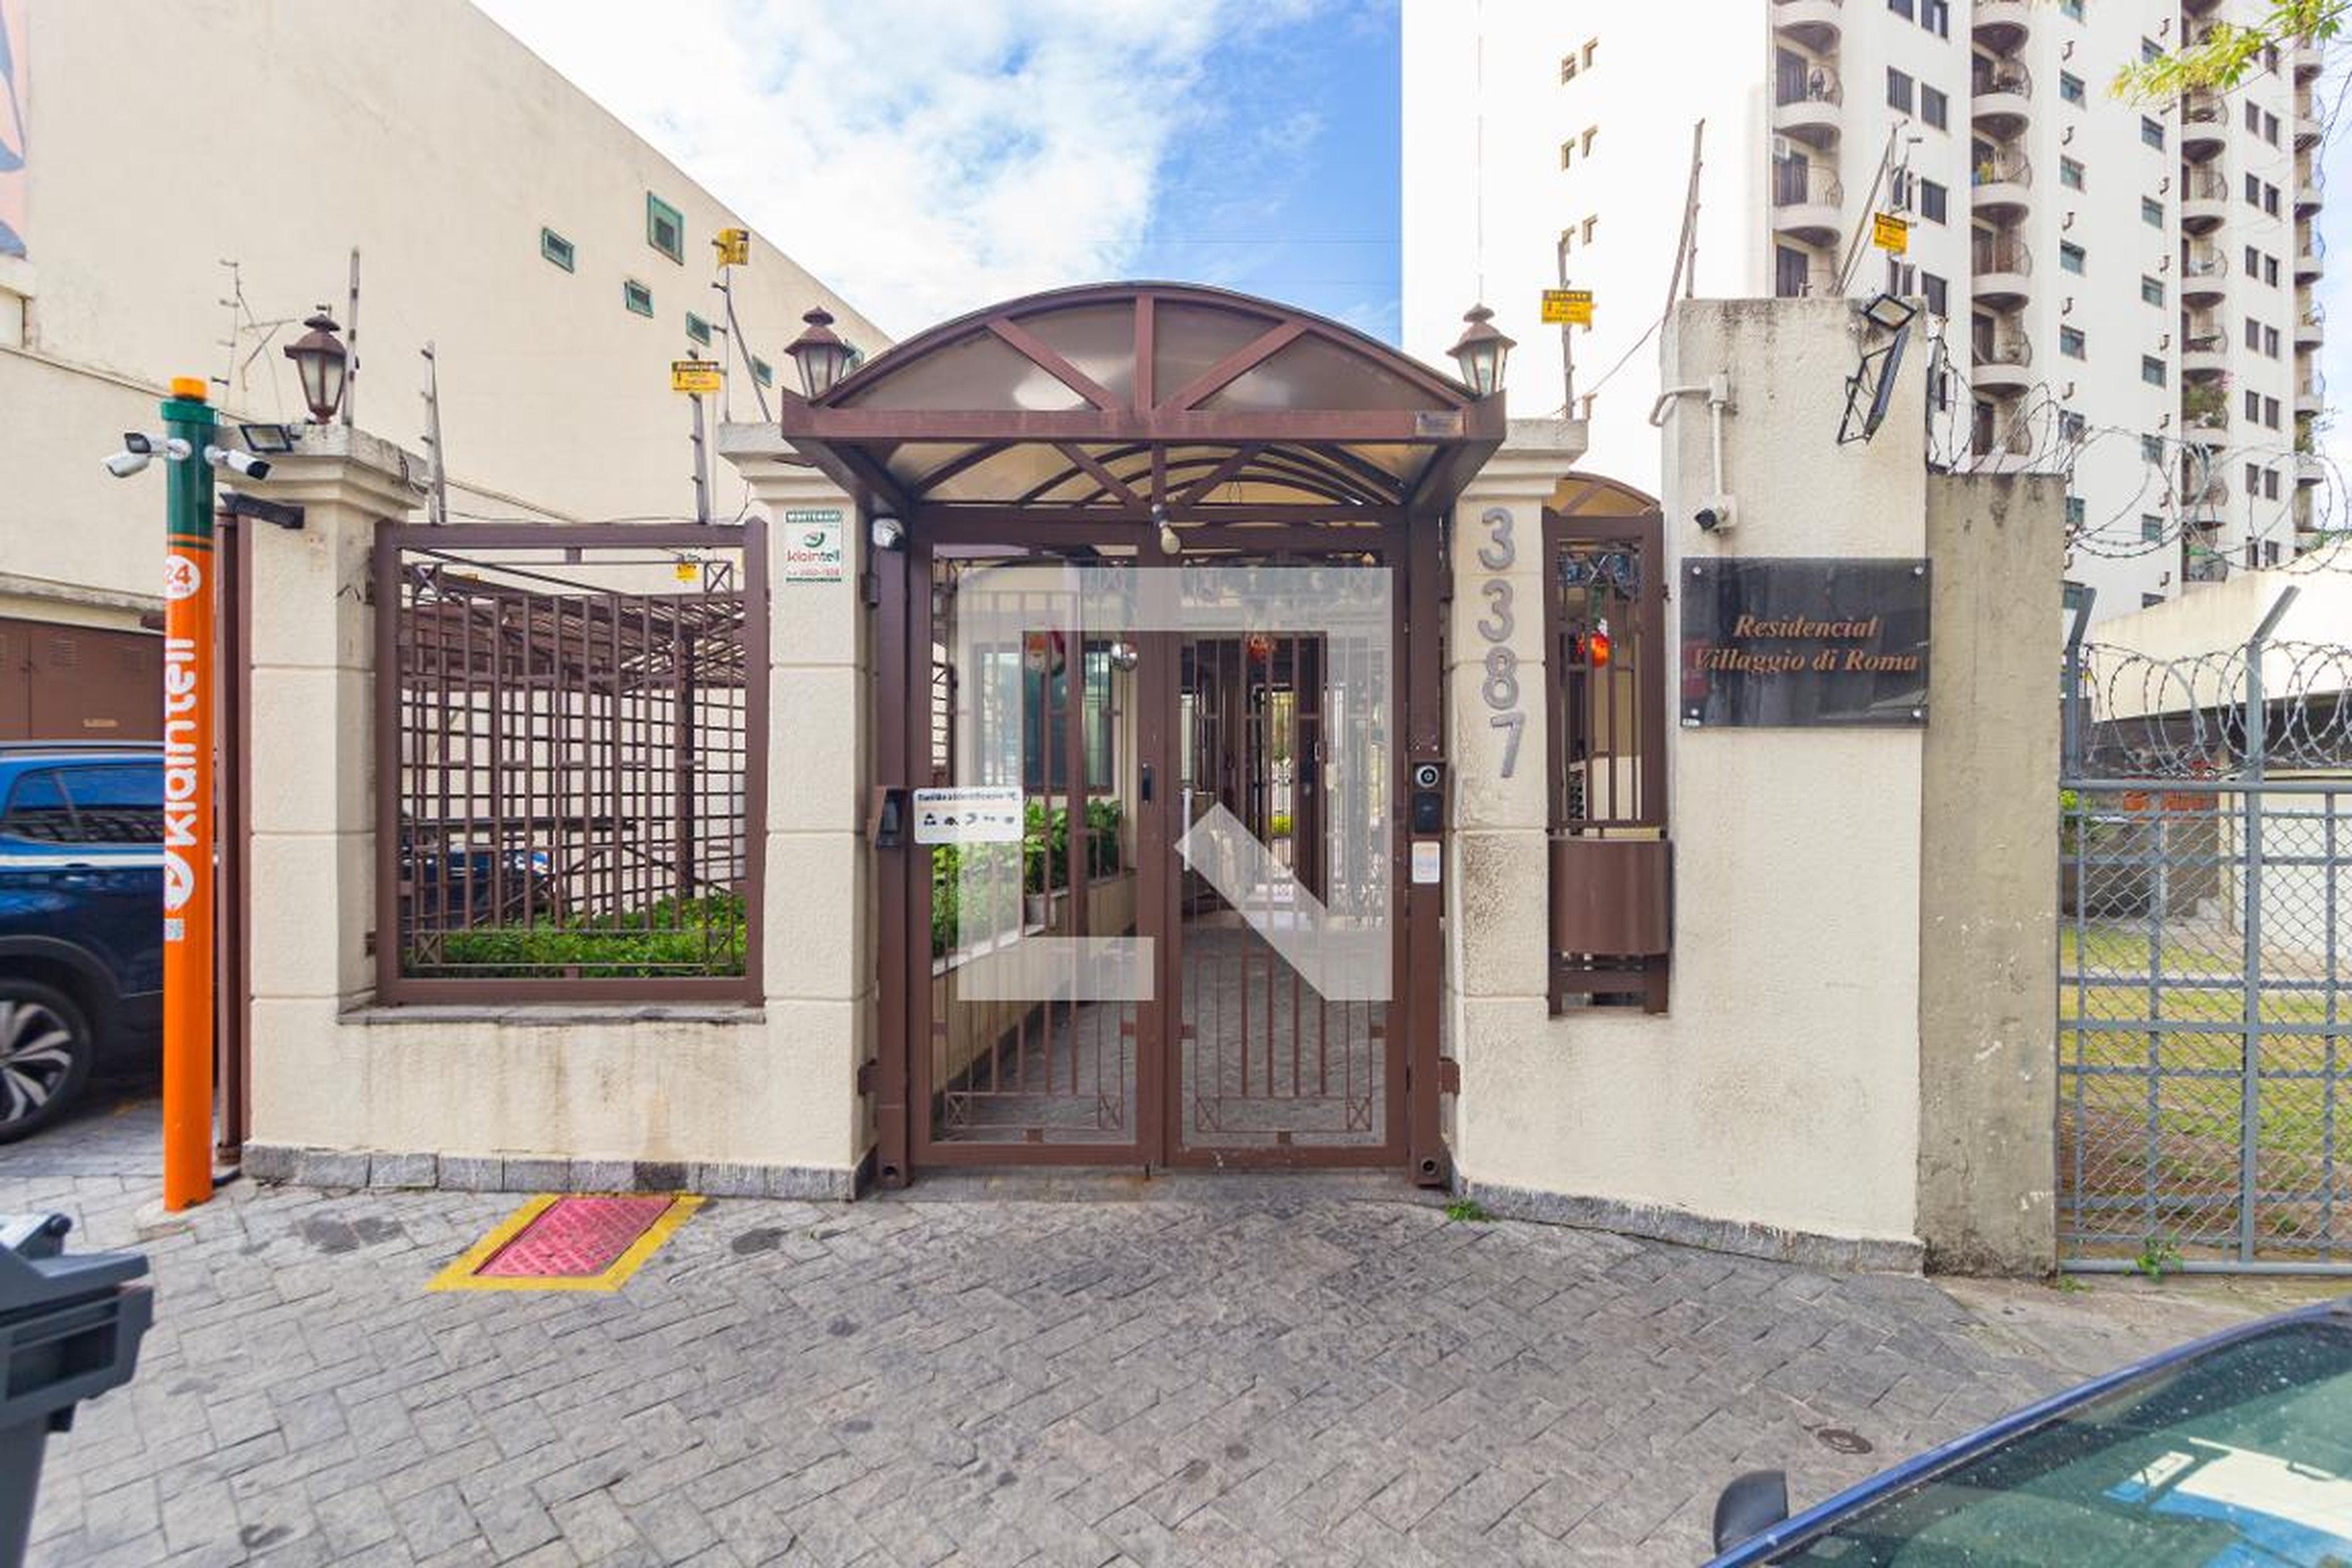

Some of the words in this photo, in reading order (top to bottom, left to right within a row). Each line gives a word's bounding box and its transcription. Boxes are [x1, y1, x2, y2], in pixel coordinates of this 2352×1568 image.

[1732, 614, 1879, 638] Residencial
[1477, 507, 1525, 778] 3387
[1694, 647, 1805, 673] Villaggio
[1812, 648, 1839, 671] di
[1844, 648, 1919, 671] Roma
